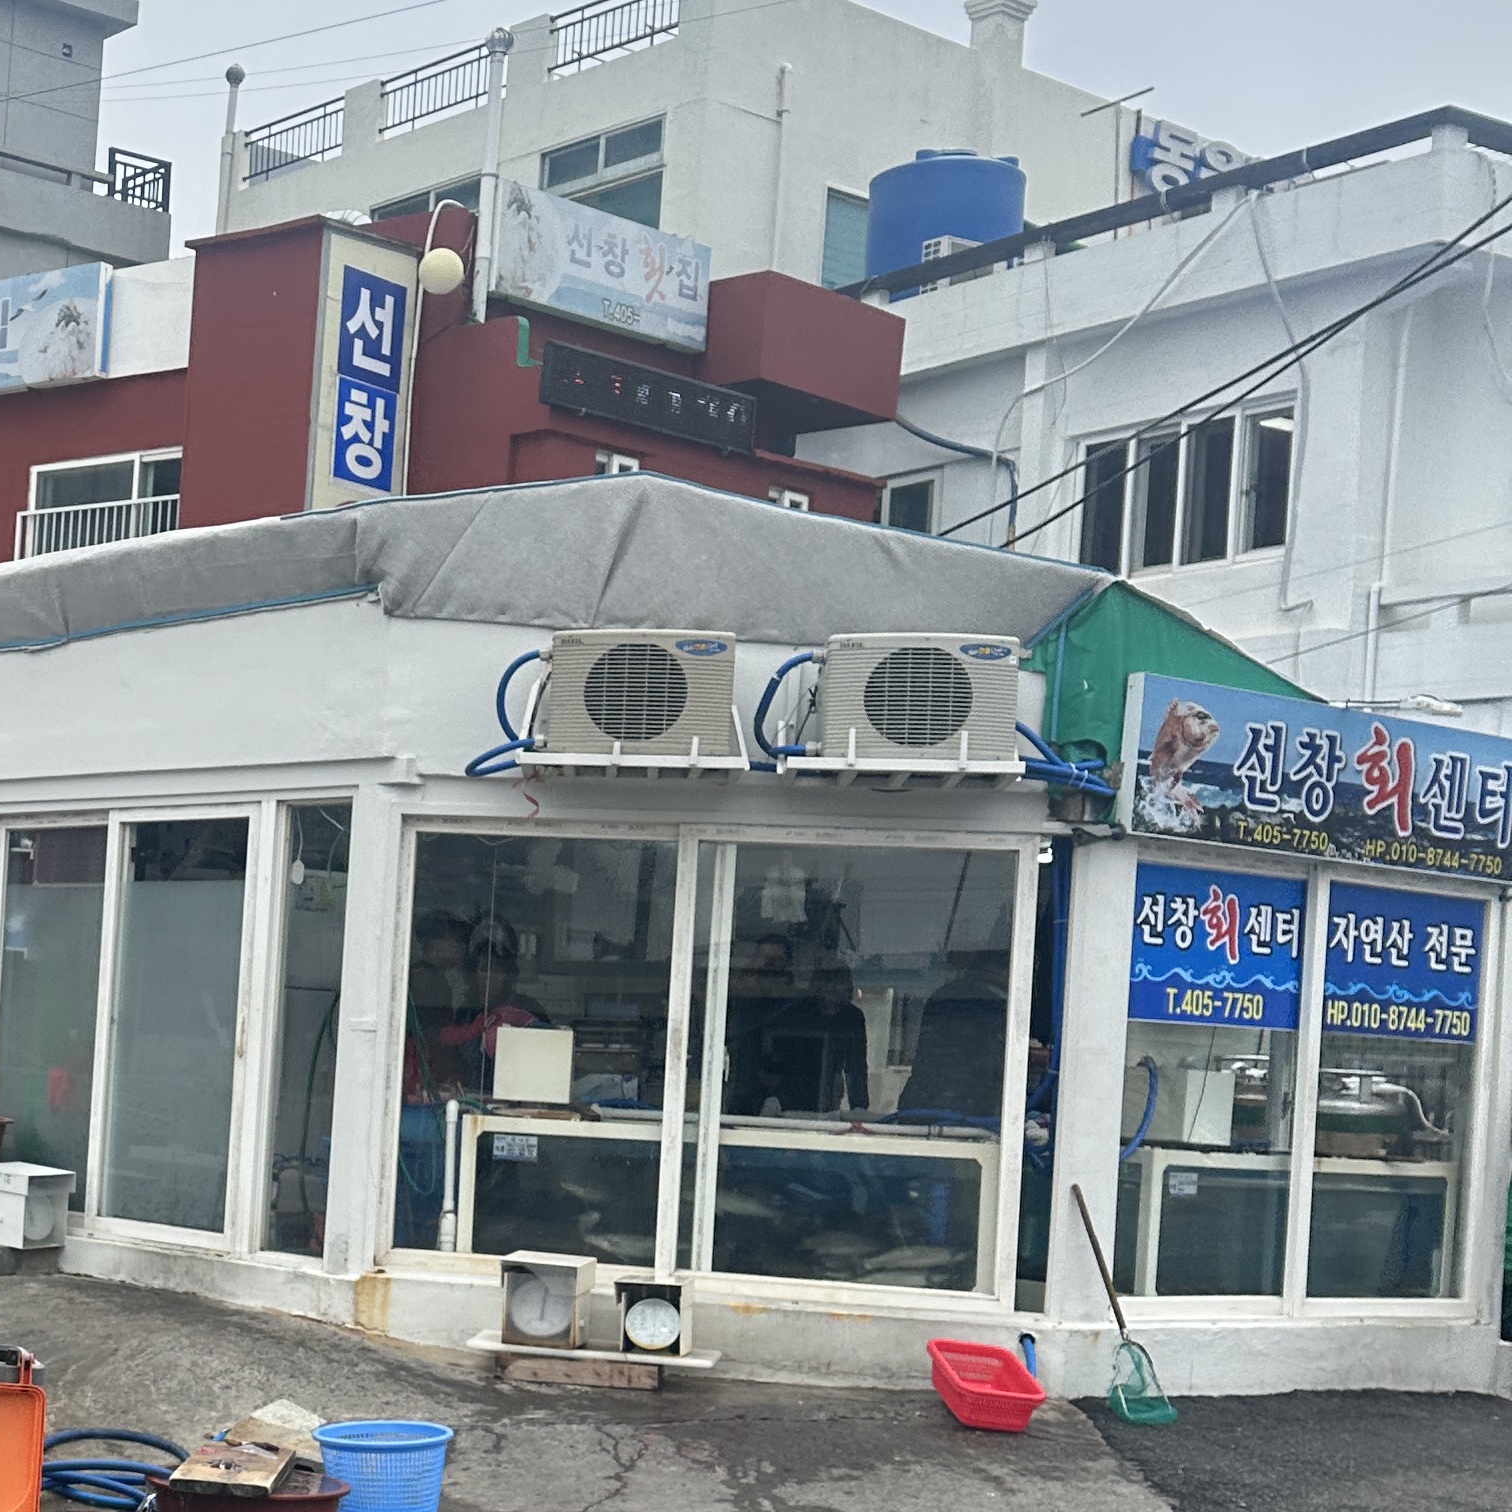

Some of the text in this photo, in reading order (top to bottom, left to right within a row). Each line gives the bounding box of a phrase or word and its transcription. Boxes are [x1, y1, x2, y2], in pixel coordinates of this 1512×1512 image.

[1237, 820, 1503, 876] T.405-7750 HP.010-8744-7750
[1329, 913, 1478, 974] 자연산 전문
[1165, 987, 1264, 1020] T.405-7750
[1326, 1000, 1471, 1037] HP.010-8744-7750
